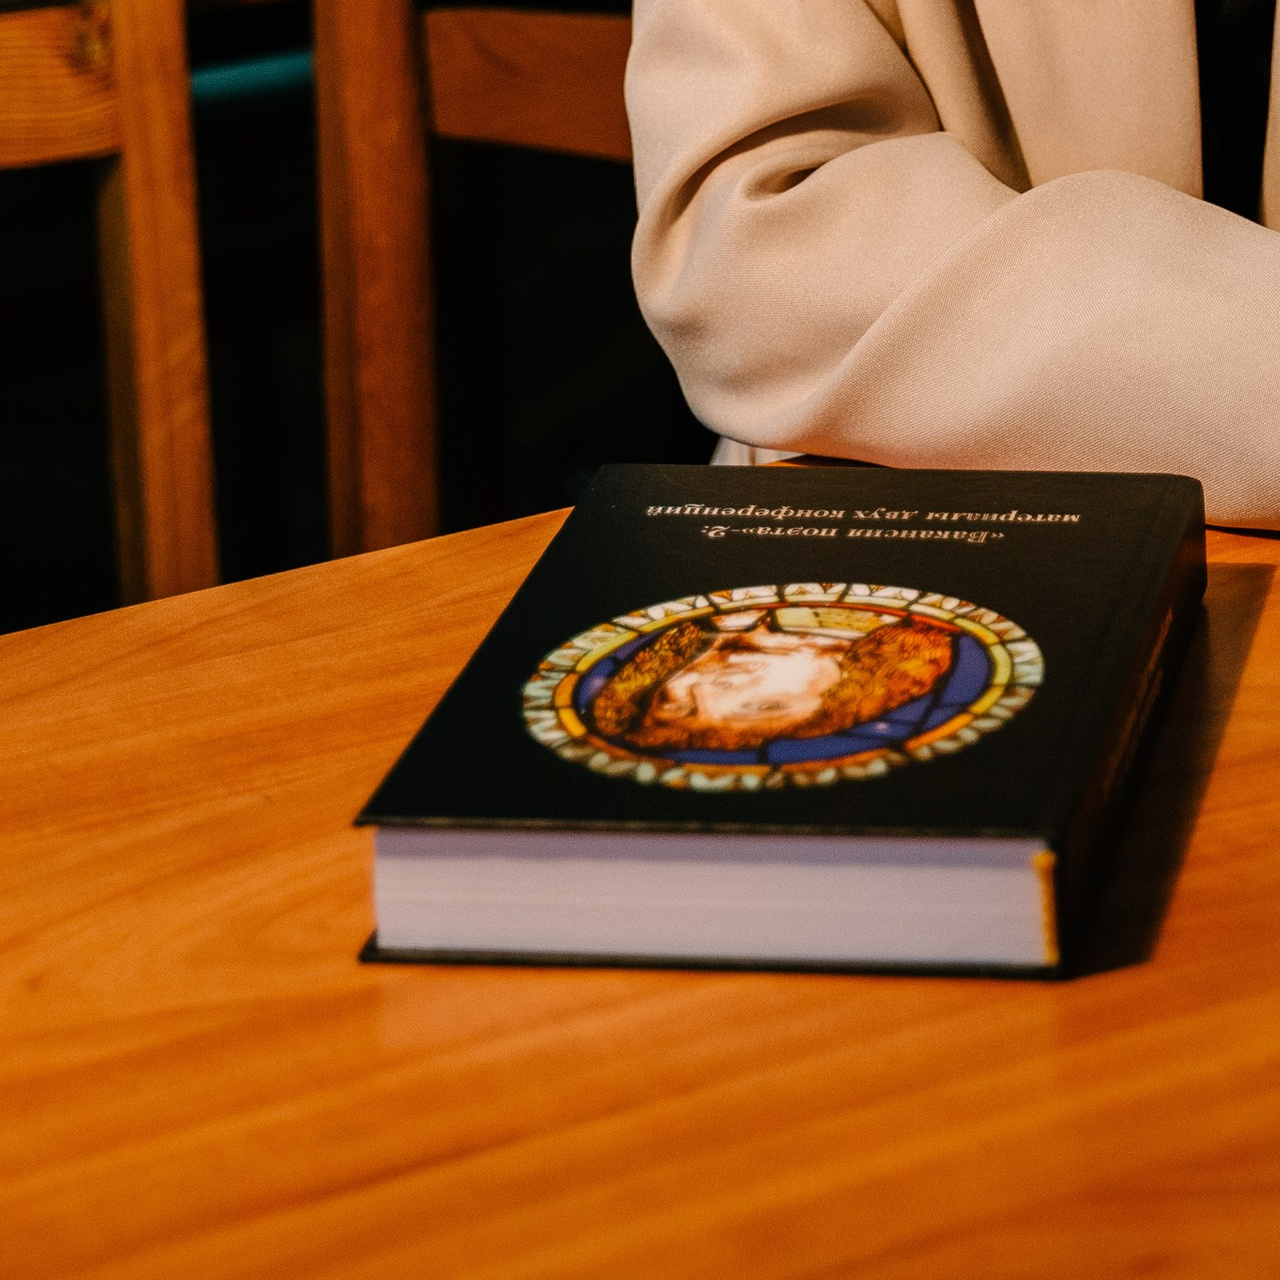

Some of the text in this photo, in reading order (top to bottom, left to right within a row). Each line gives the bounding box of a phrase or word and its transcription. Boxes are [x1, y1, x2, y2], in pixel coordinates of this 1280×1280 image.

[646, 502, 1081, 524] материалы двух конференций
[847, 526, 1005, 544] «Вакансия
